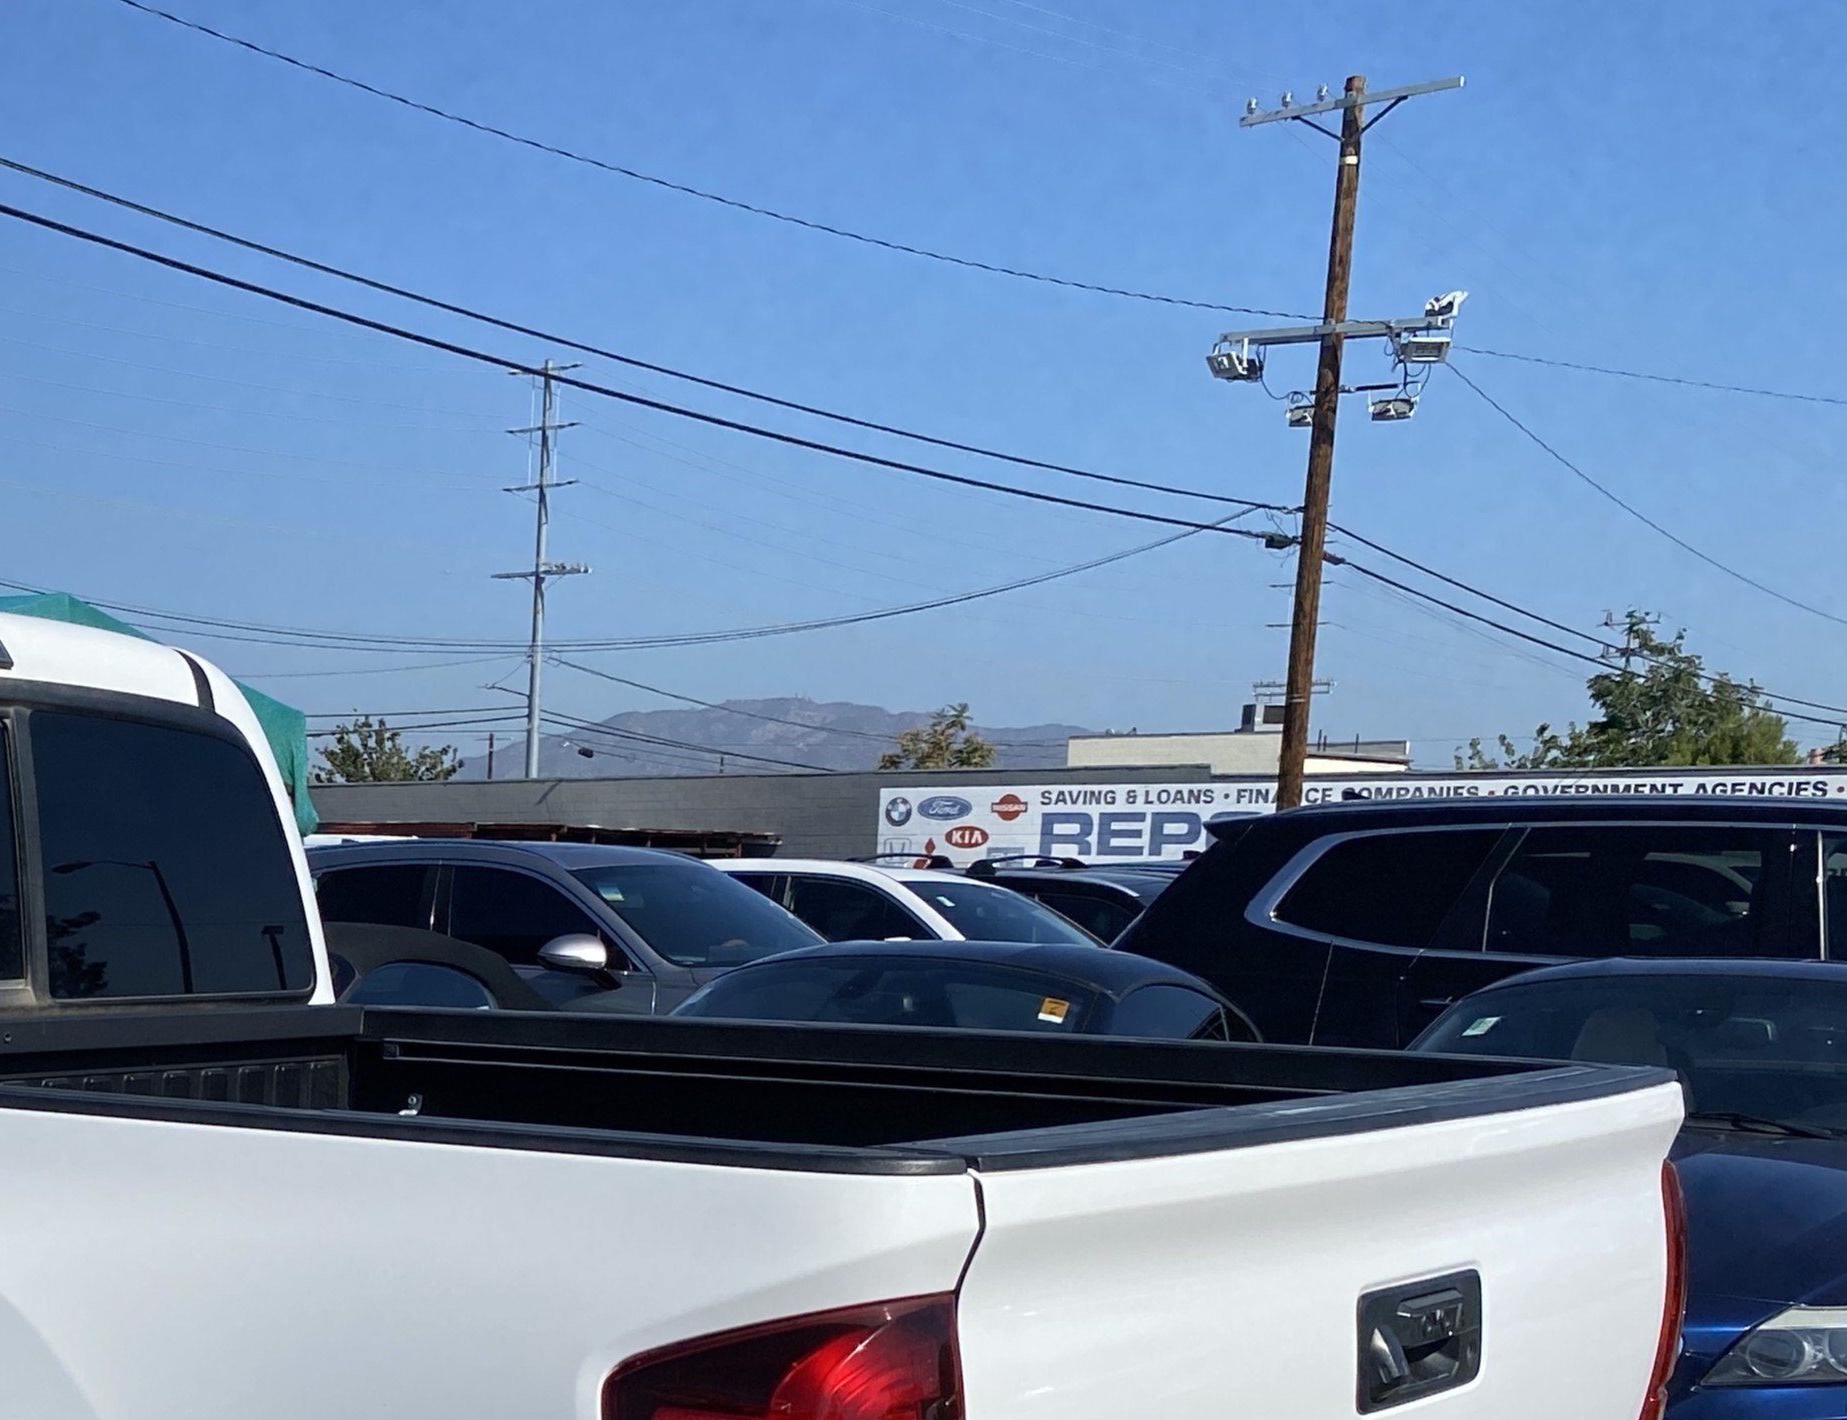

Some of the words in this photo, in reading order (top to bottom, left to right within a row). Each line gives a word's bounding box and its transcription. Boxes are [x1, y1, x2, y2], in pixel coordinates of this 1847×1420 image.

[1040, 789, 1116, 806] SAVING
[1125, 789, 1138, 805] &
[1143, 789, 1215, 805] LOANS
[1236, 787, 1333, 804] FINCE
[1694, 781, 1829, 798] AGENCIES
[927, 800, 961, 815] Ford
[951, 830, 983, 844] KIA
[1038, 811, 1263, 857] REP
